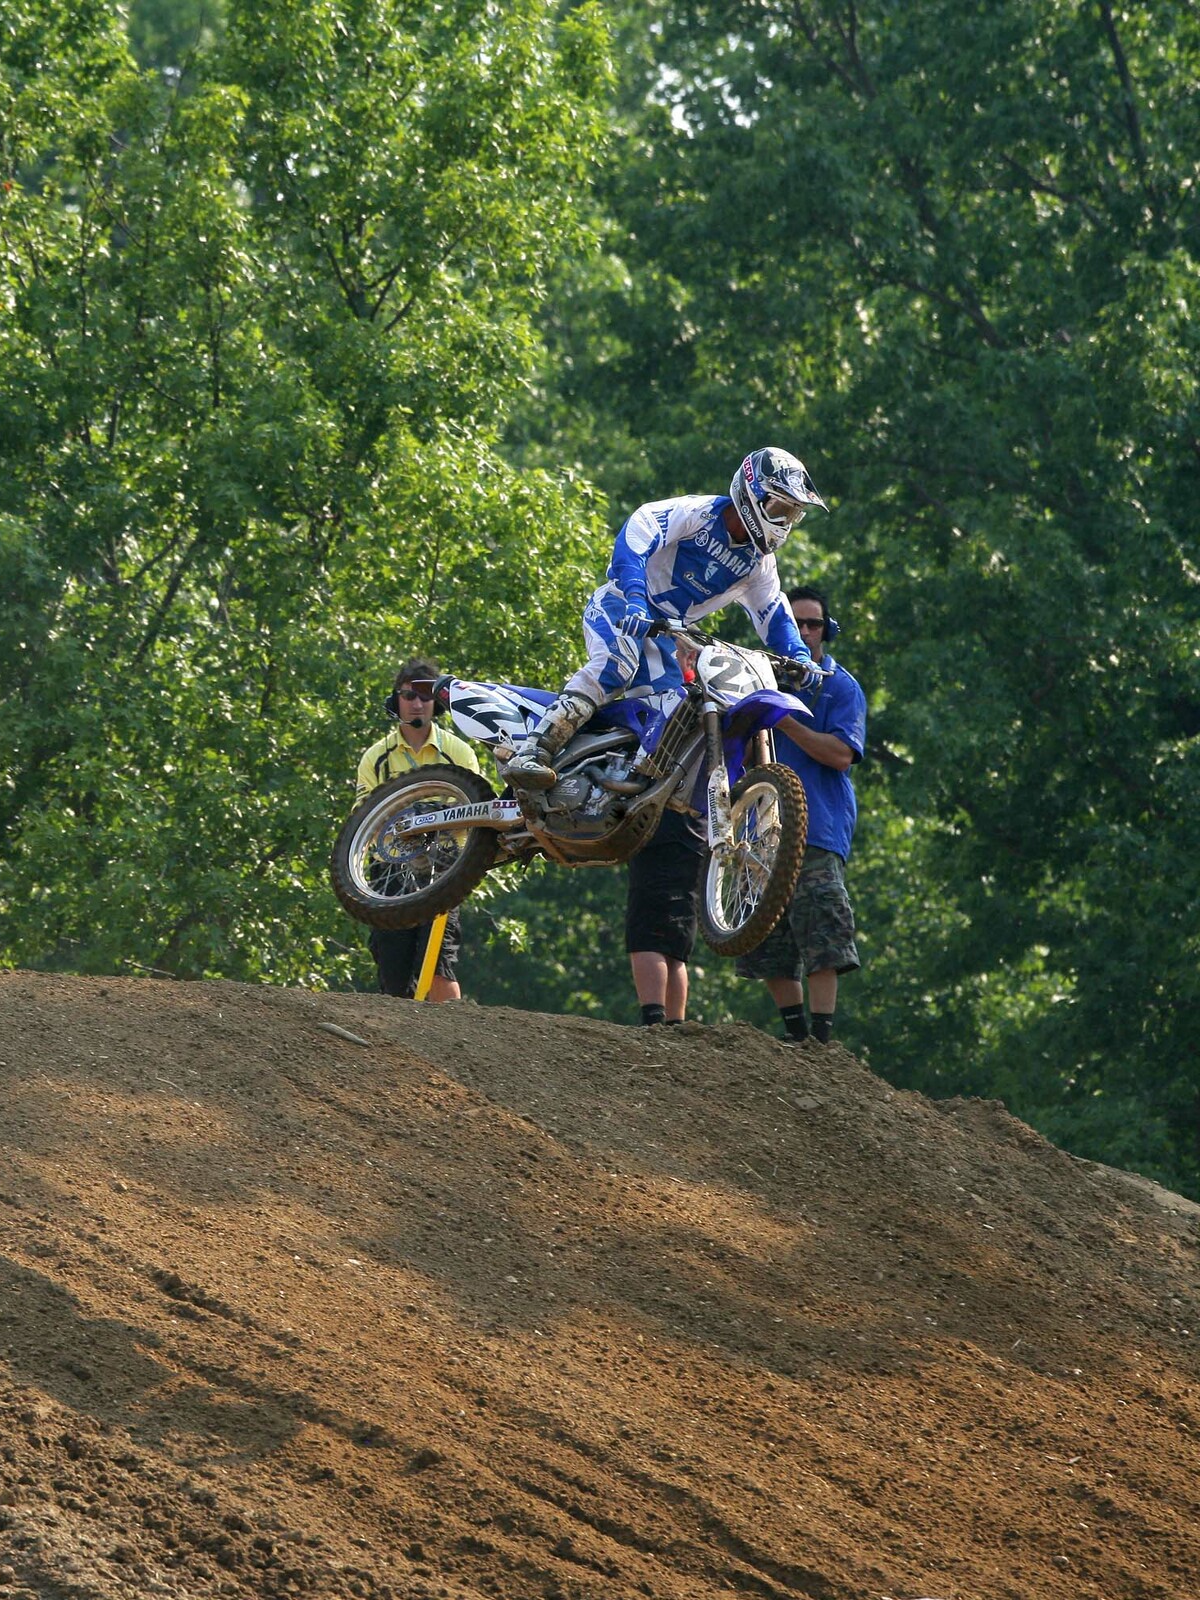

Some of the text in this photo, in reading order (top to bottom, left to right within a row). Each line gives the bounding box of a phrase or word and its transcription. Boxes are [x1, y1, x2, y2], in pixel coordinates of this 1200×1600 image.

[706, 537, 751, 577] YAMAHA
[451, 688, 526, 735] 22
[443, 804, 490, 822] YAMAHA
